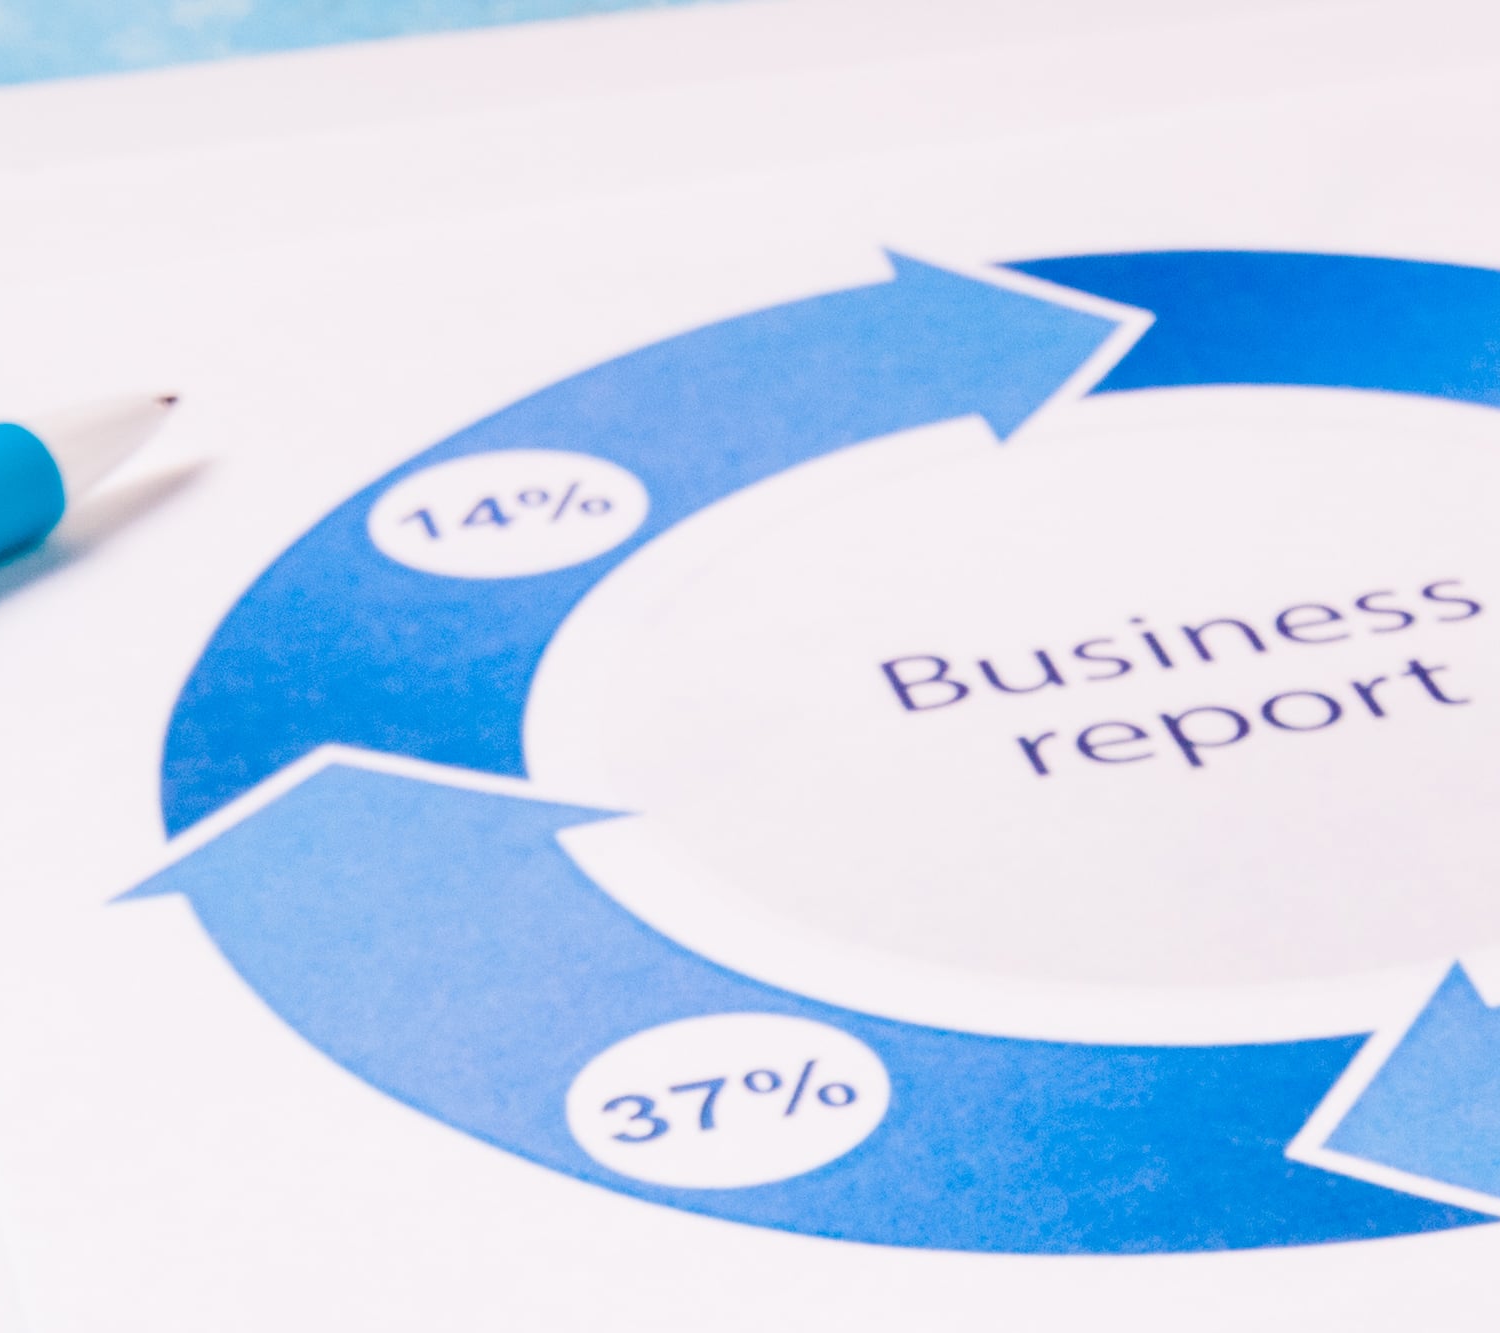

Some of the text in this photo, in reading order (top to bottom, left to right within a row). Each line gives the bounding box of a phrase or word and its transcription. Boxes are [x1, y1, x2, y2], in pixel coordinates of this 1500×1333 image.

[399, 479, 613, 540] 14%
[880, 578, 1483, 712] Business
[1016, 658, 1472, 777] report
[601, 1058, 858, 1144] 37%
